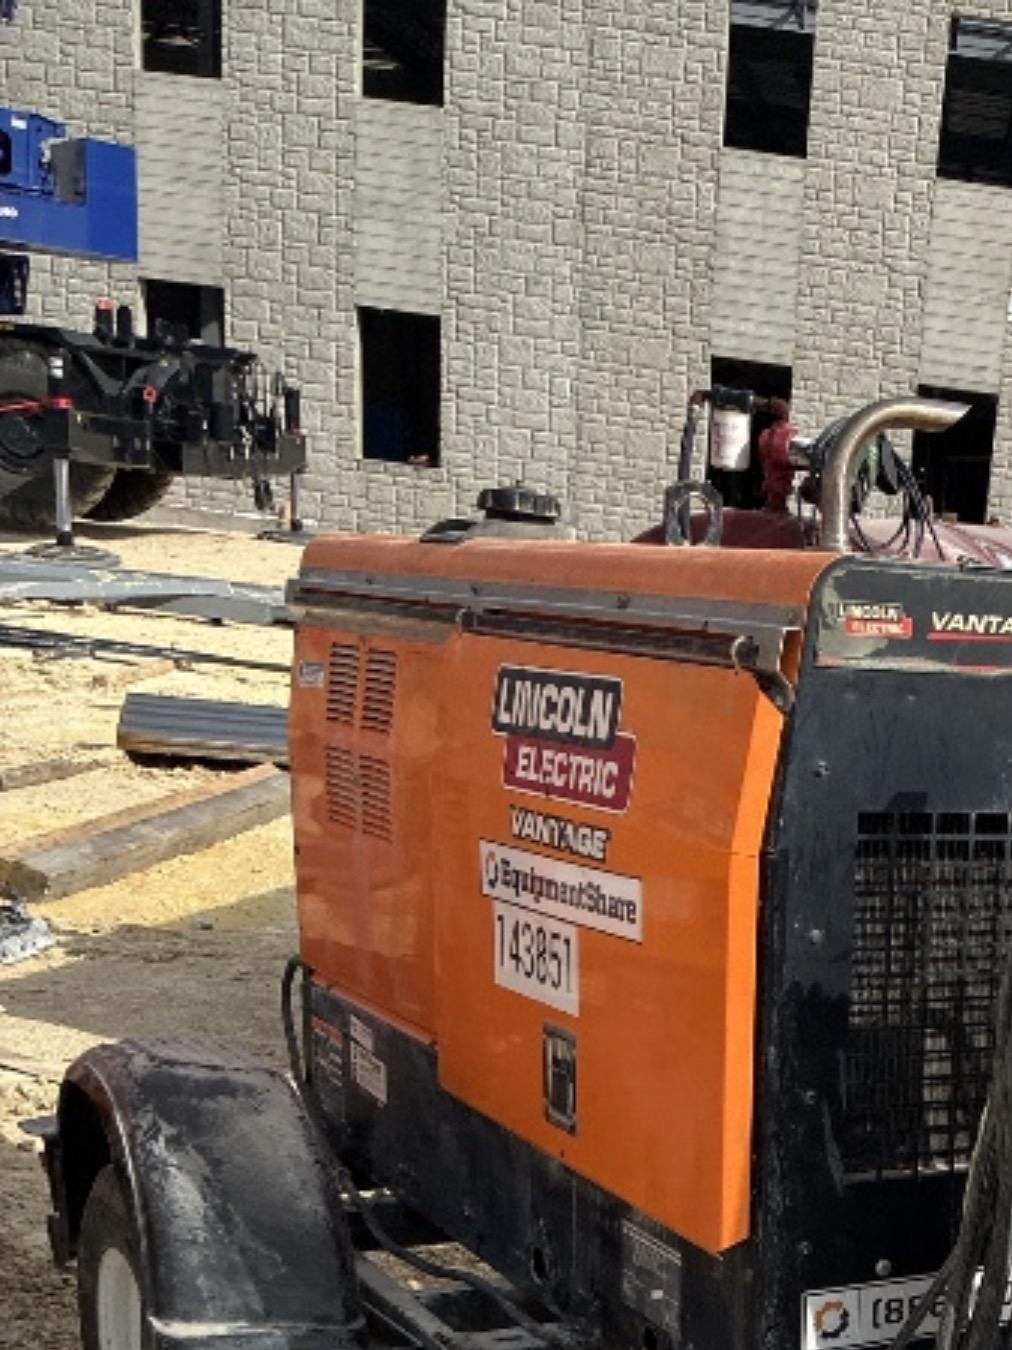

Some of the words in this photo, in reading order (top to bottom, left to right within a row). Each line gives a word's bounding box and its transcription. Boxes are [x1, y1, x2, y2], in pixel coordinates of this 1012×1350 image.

[497, 676, 616, 742] LINCOLN
[515, 745, 619, 799] ELECTRIC
[510, 805, 613, 862] VANTAGE
[500, 857, 637, 925] EquipmentShare
[497, 914, 572, 994] 143851
